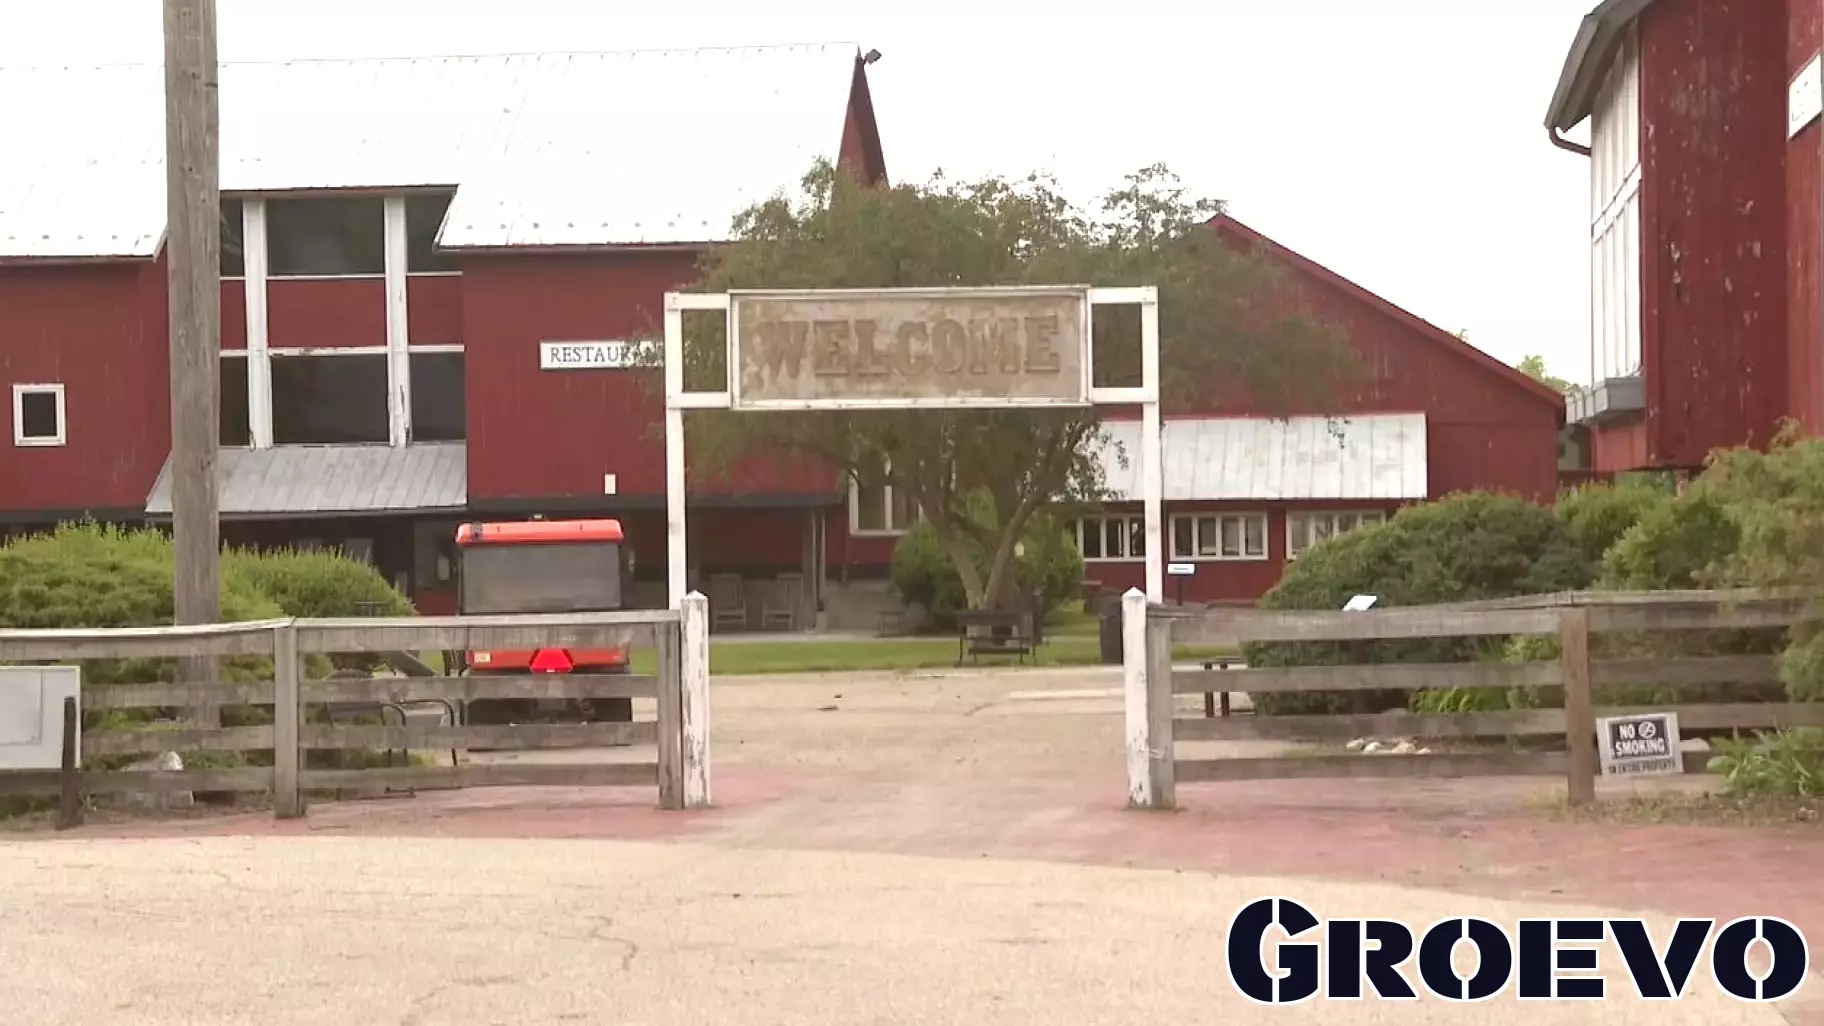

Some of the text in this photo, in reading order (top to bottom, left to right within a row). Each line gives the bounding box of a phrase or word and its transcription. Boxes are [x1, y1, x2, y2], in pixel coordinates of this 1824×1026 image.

[549, 345, 665, 363] RESTAUR
[752, 315, 1060, 379] WELCOME
[1619, 723, 1636, 740] NO
[1615, 737, 1665, 758] SMOKING
